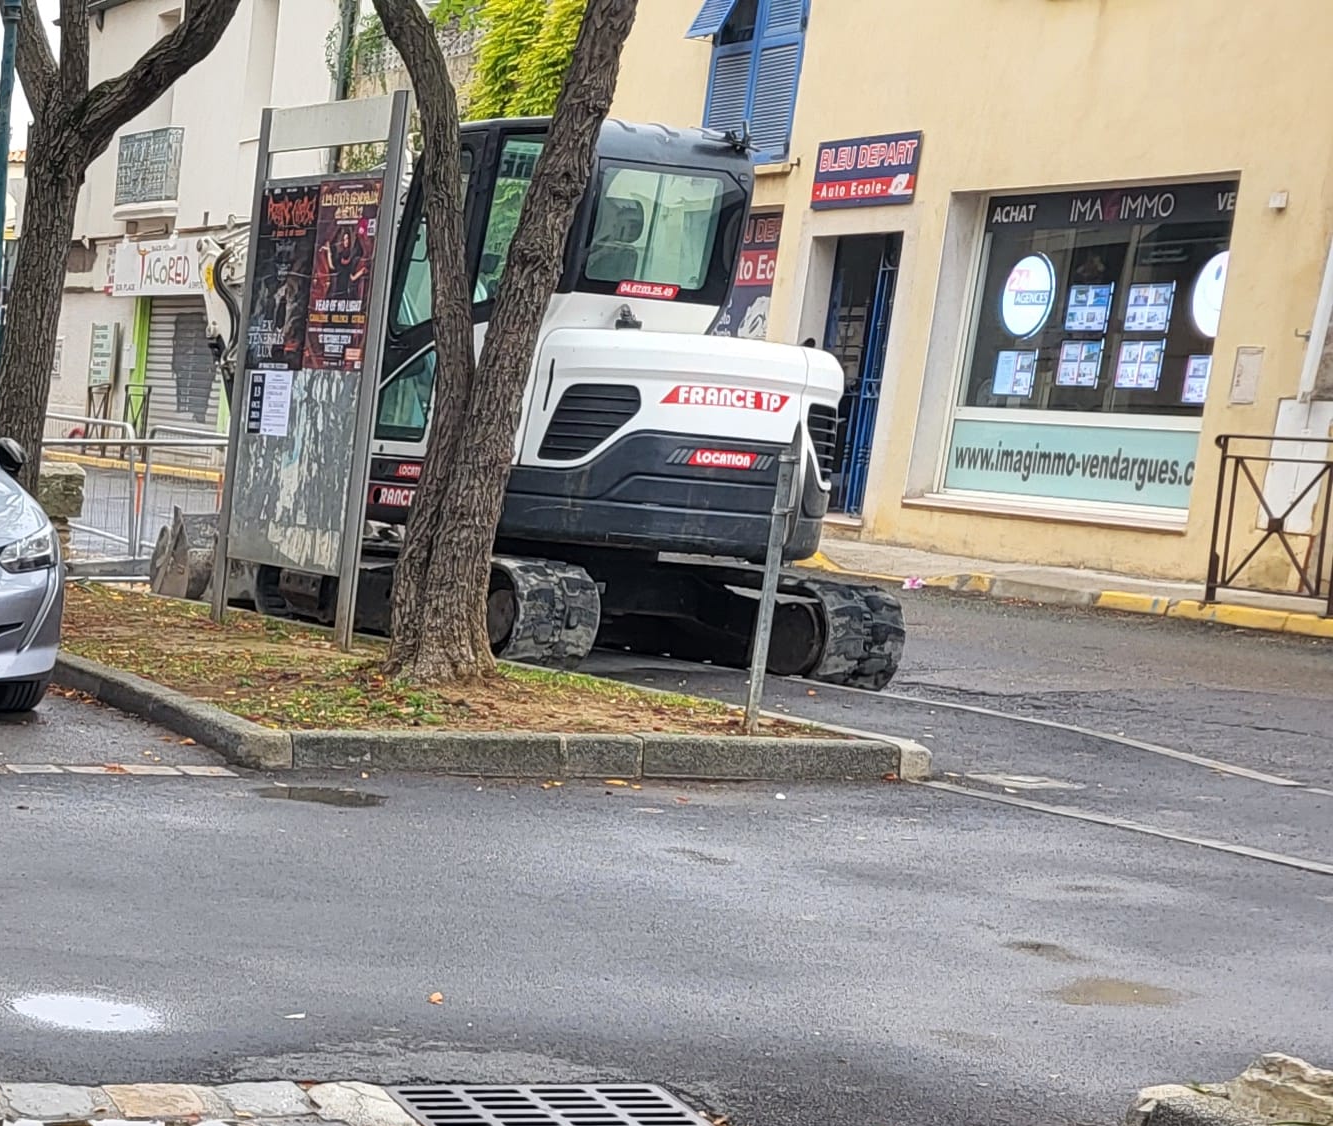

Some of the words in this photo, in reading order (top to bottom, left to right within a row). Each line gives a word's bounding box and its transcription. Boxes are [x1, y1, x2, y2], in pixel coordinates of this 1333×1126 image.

[819, 145, 857, 172] BLEU
[857, 139, 918, 168] DEPART
[992, 204, 1036, 223] ACHAT
[1069, 193, 1175, 223] IMAGIMMO
[1217, 192, 1236, 211] VE
[756, 254, 775, 279] Ec
[1015, 291, 1051, 304] AGENCES
[678, 386, 755, 409] FRANCE
[761, 392, 781, 412] TP
[398, 463, 421, 478] LOCATI
[696, 451, 751, 467] LOCATION
[954, 440, 1195, 491] www.imagimmo-vendargues.c
